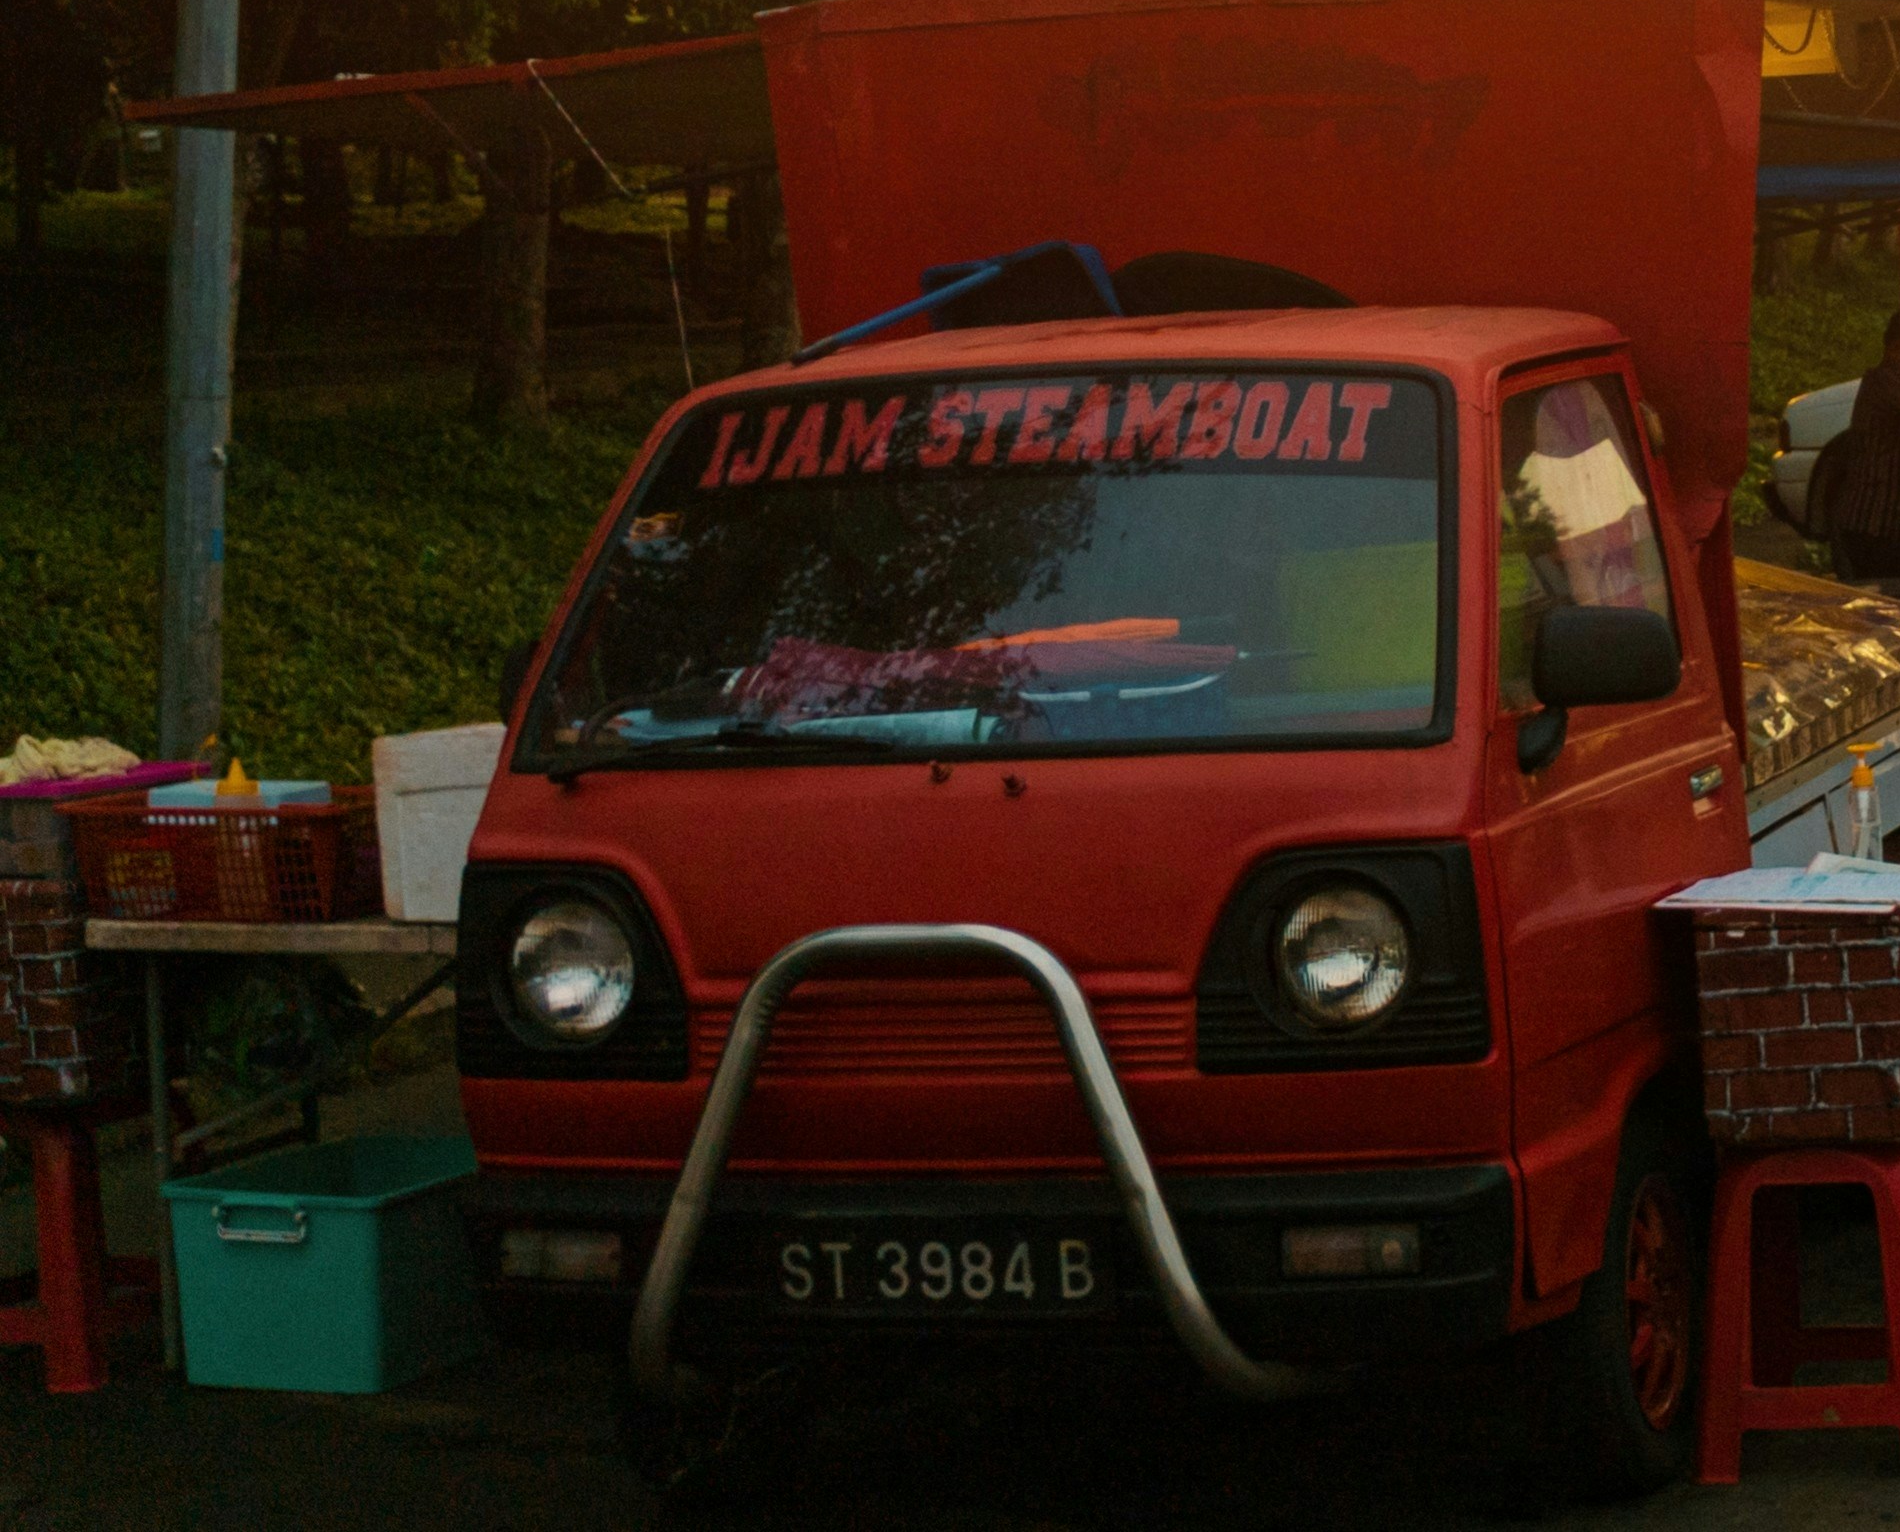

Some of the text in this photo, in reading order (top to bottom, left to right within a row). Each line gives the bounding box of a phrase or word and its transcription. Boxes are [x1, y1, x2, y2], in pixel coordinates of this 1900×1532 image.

[697, 379, 1394, 490] IJAM STEAMBOAT
[779, 1238, 1096, 1301] ST 3984 B
